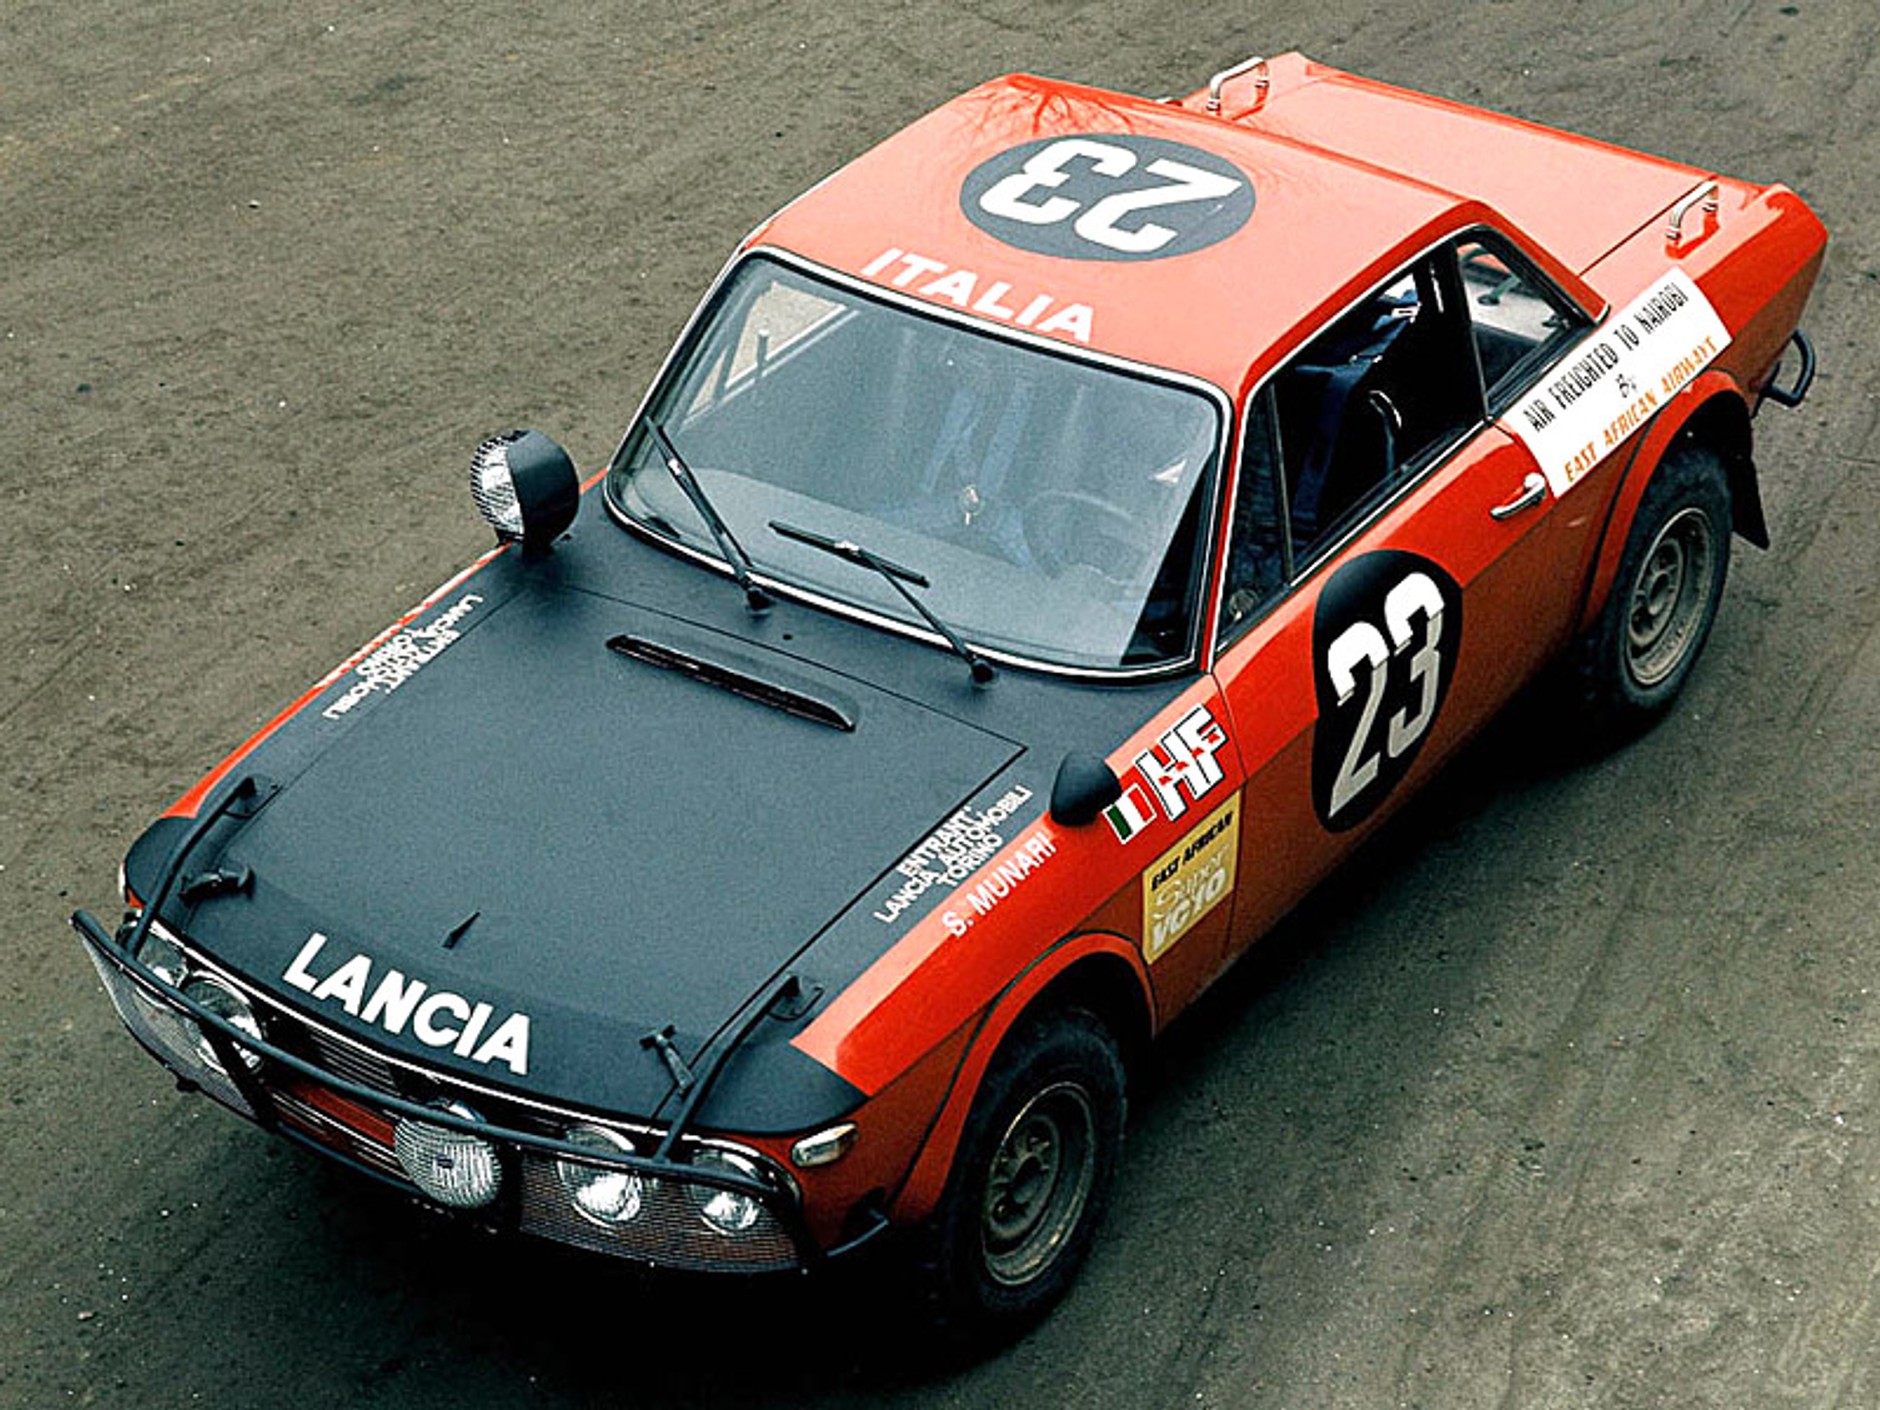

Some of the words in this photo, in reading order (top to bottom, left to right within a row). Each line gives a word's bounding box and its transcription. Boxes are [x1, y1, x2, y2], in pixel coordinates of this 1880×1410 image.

[979, 138, 1243, 253] 23
[860, 247, 1095, 343] ITALIA
[1523, 398, 1557, 432] AIR
[1548, 342, 1620, 410] FREIGHTED
[1613, 324, 1640, 351] TO
[1633, 282, 1689, 335] NAIROBI
[1564, 441, 1598, 482] EAST
[1603, 387, 1659, 447] AFRICAN
[1327, 571, 1445, 818] 23
[1135, 703, 1229, 823] HF
[873, 867, 940, 923] LANCIA
[937, 784, 1034, 866] AUTOMOBILI
[936, 832, 1003, 888] TORINO
[942, 910, 974, 937] S.
[966, 831, 1057, 916] MUNARI
[282, 932, 530, 1076] LANCIA
